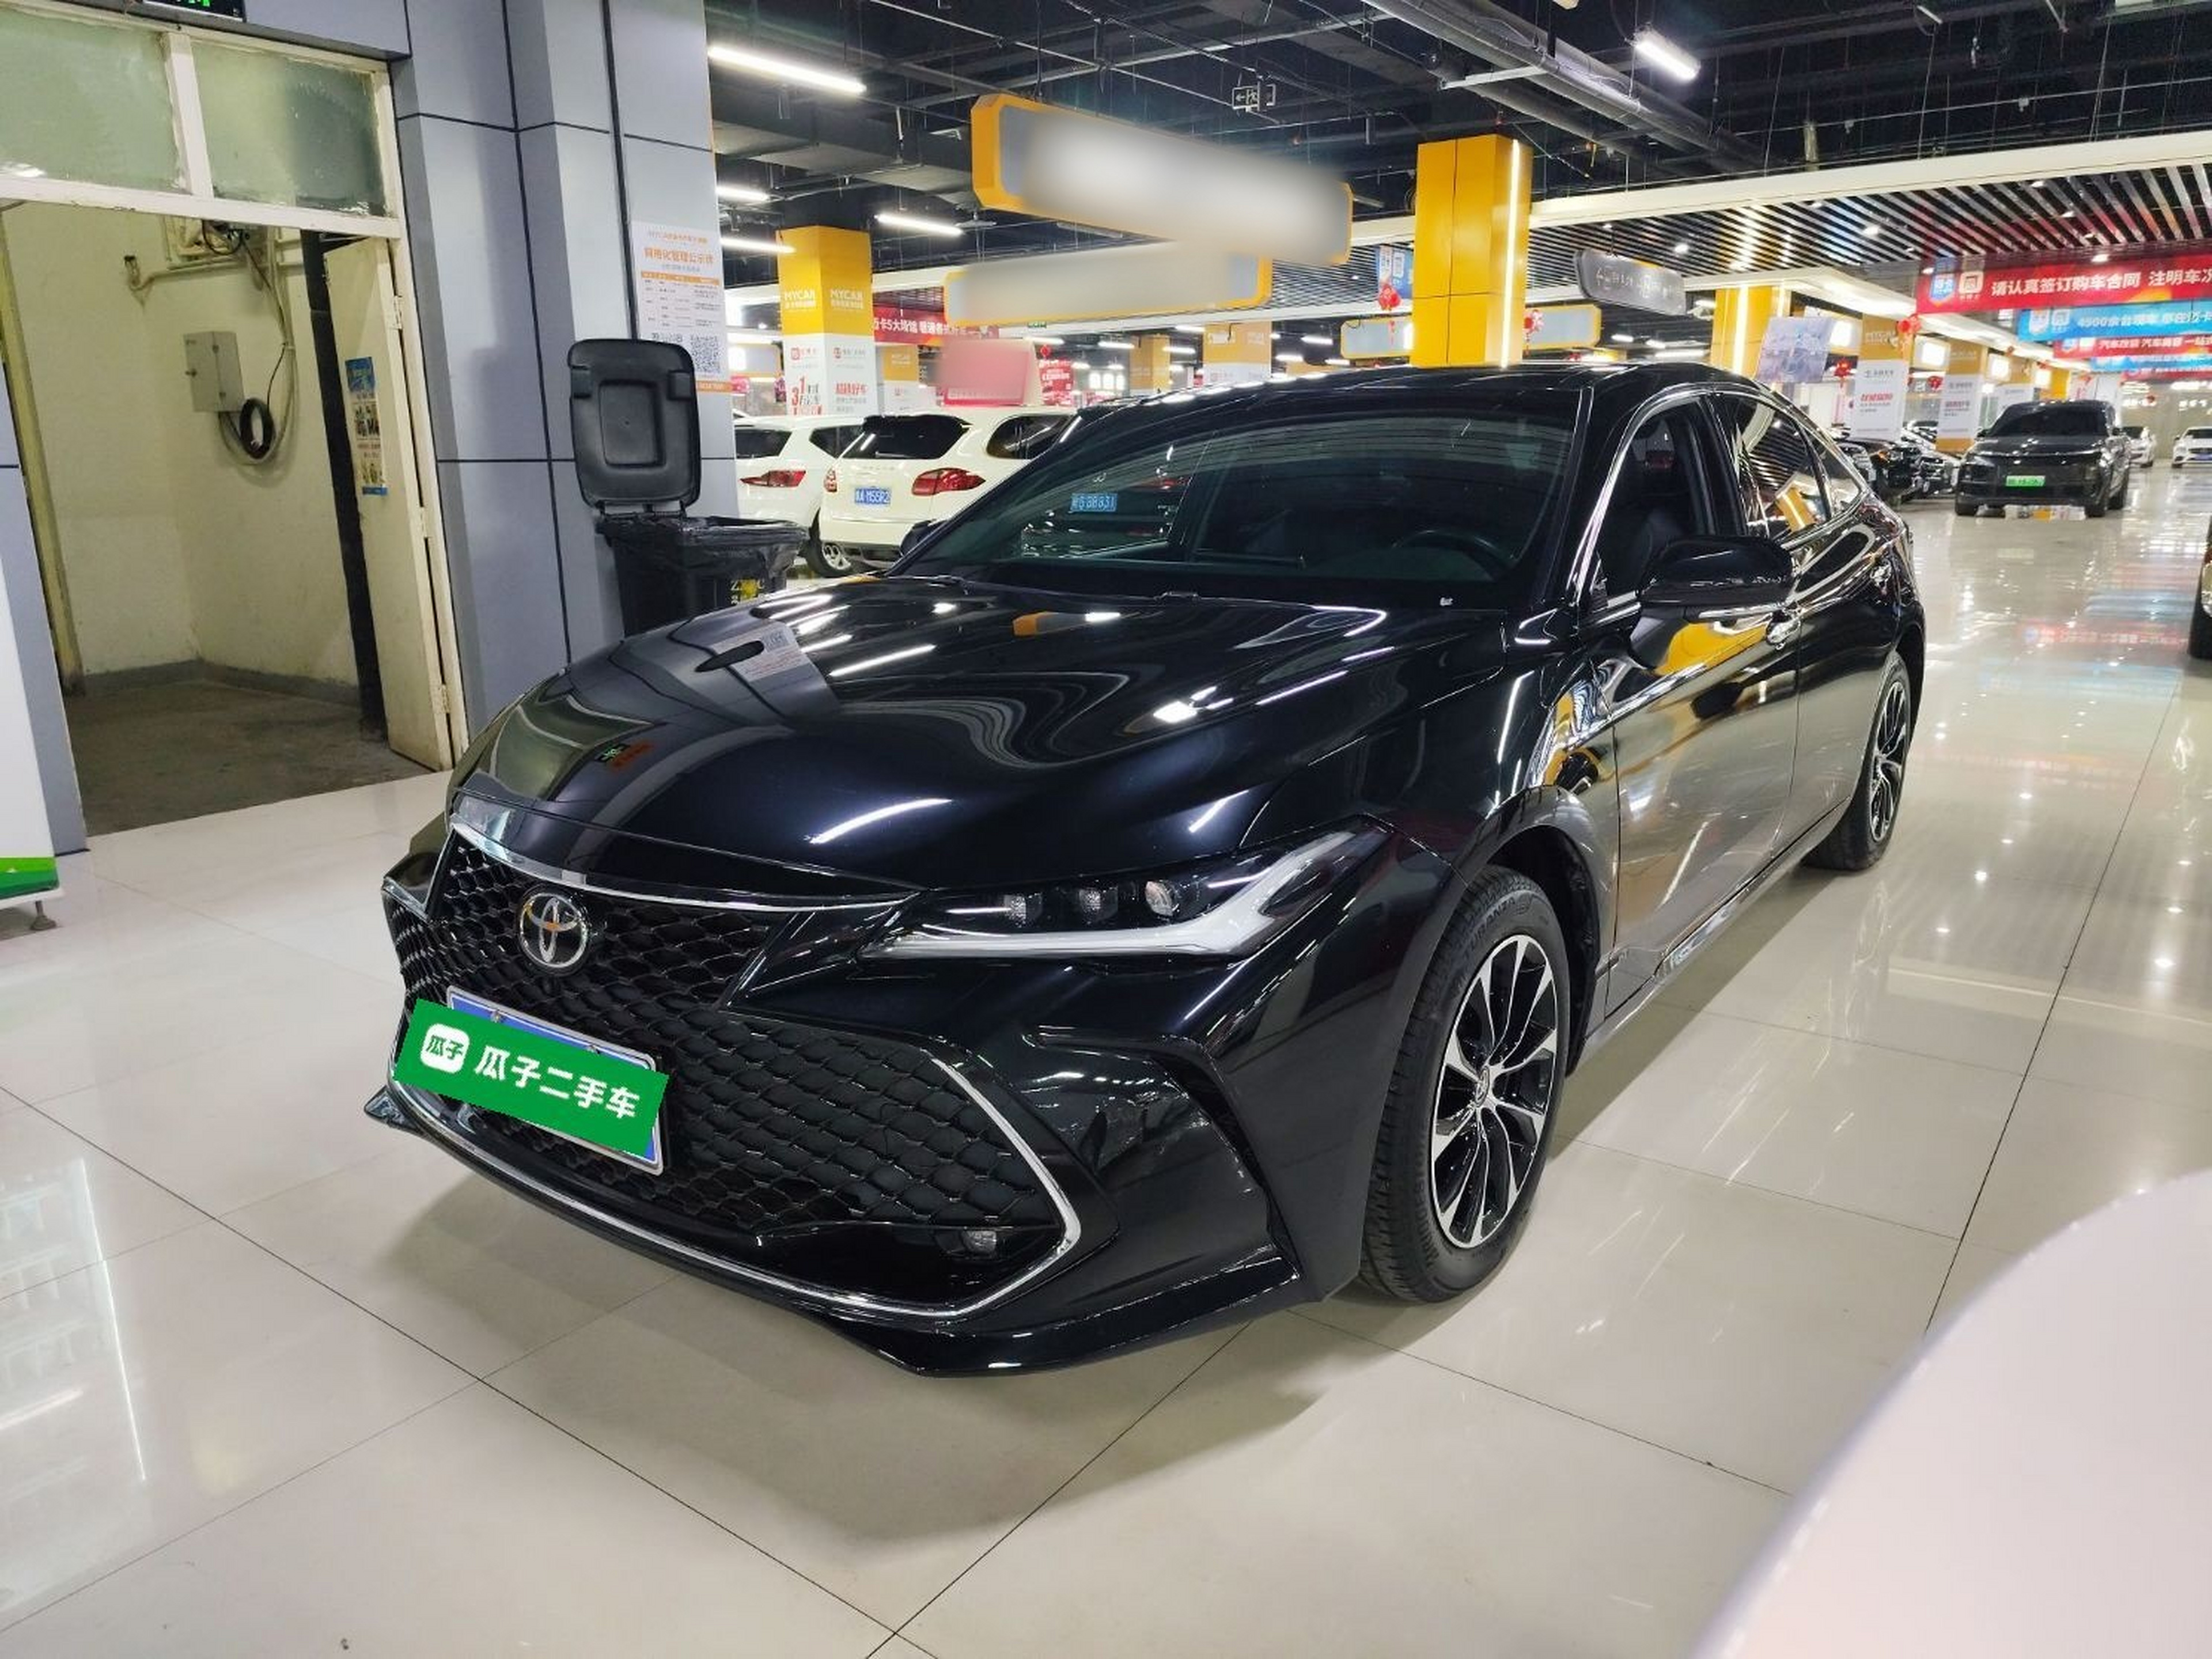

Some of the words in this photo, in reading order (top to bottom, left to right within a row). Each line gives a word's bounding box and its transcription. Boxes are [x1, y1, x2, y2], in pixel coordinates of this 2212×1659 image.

[1991, 271, 2141, 296] 请认真签订购车合同
[785, 288, 815, 301] MYCAR
[830, 289, 863, 301] MYCAR
